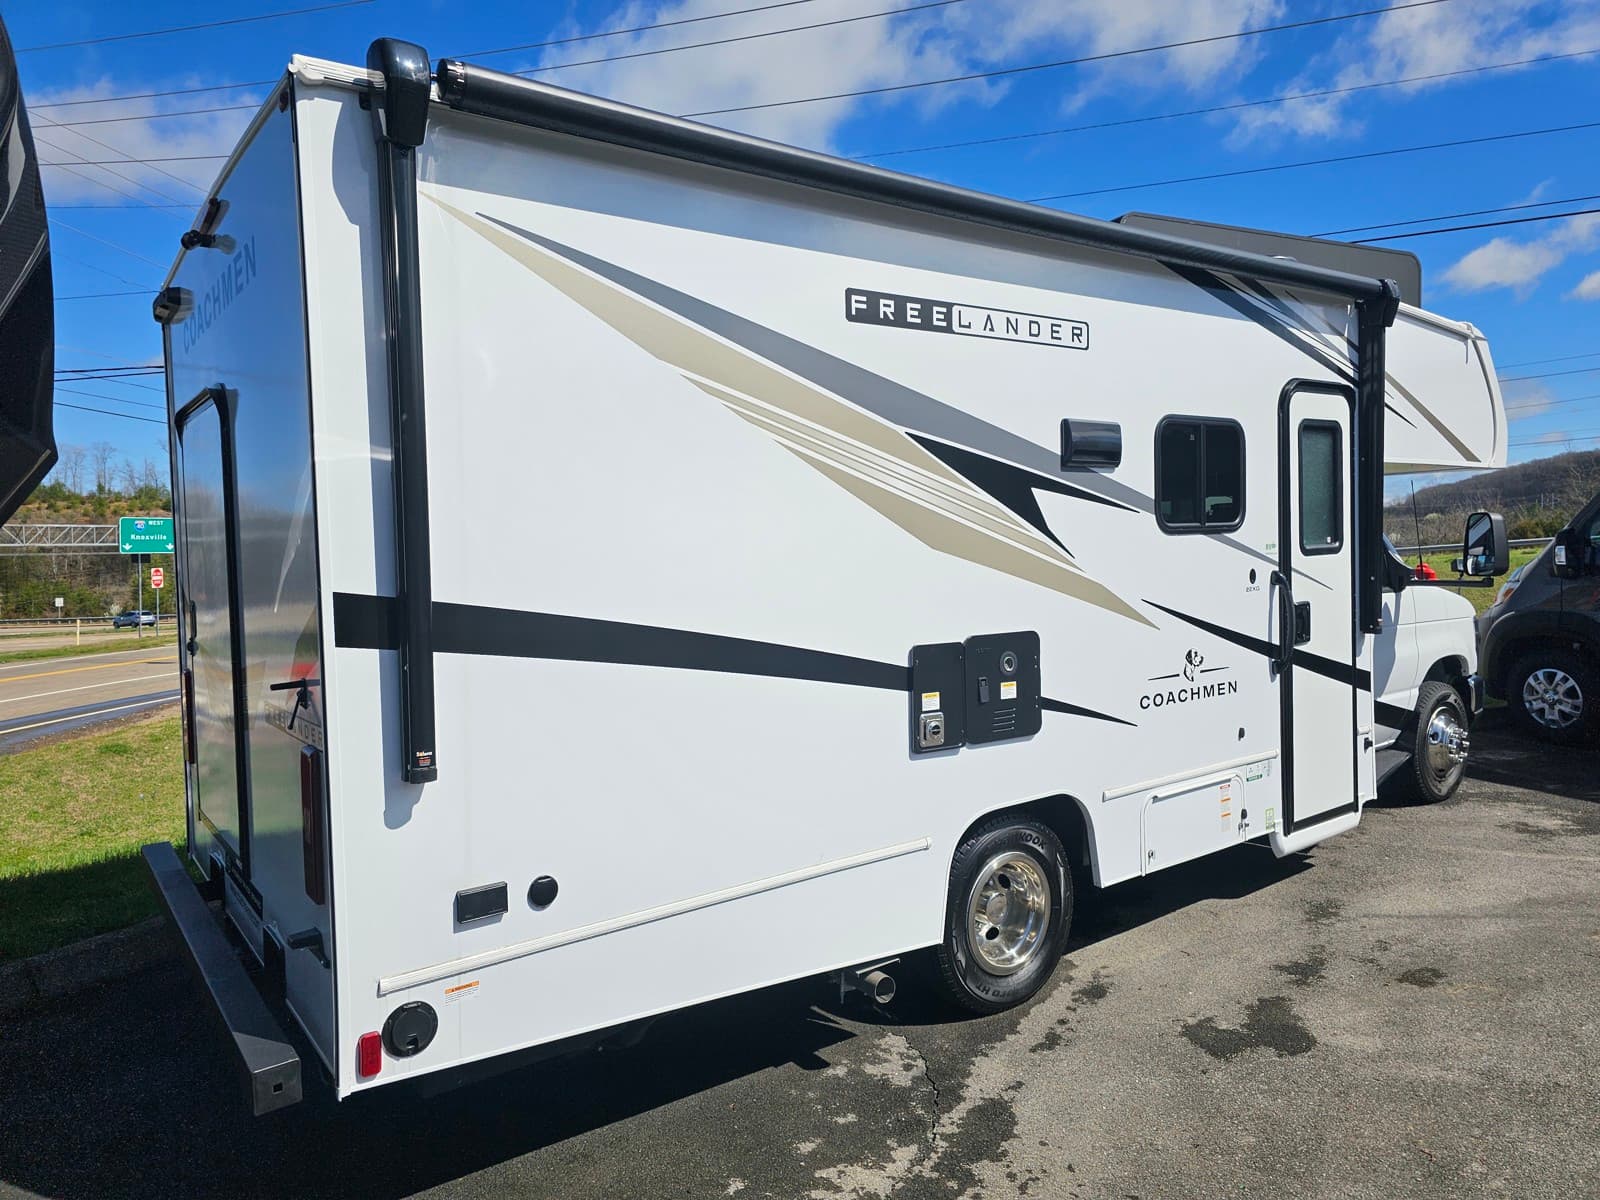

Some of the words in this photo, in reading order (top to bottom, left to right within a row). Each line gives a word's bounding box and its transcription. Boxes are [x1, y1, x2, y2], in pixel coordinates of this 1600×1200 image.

[183, 234, 257, 355] COACHMEN
[850, 294, 1083, 343] FREELANDER
[1139, 680, 1238, 710] COACHMEN
[265, 704, 323, 748] FREENDER
